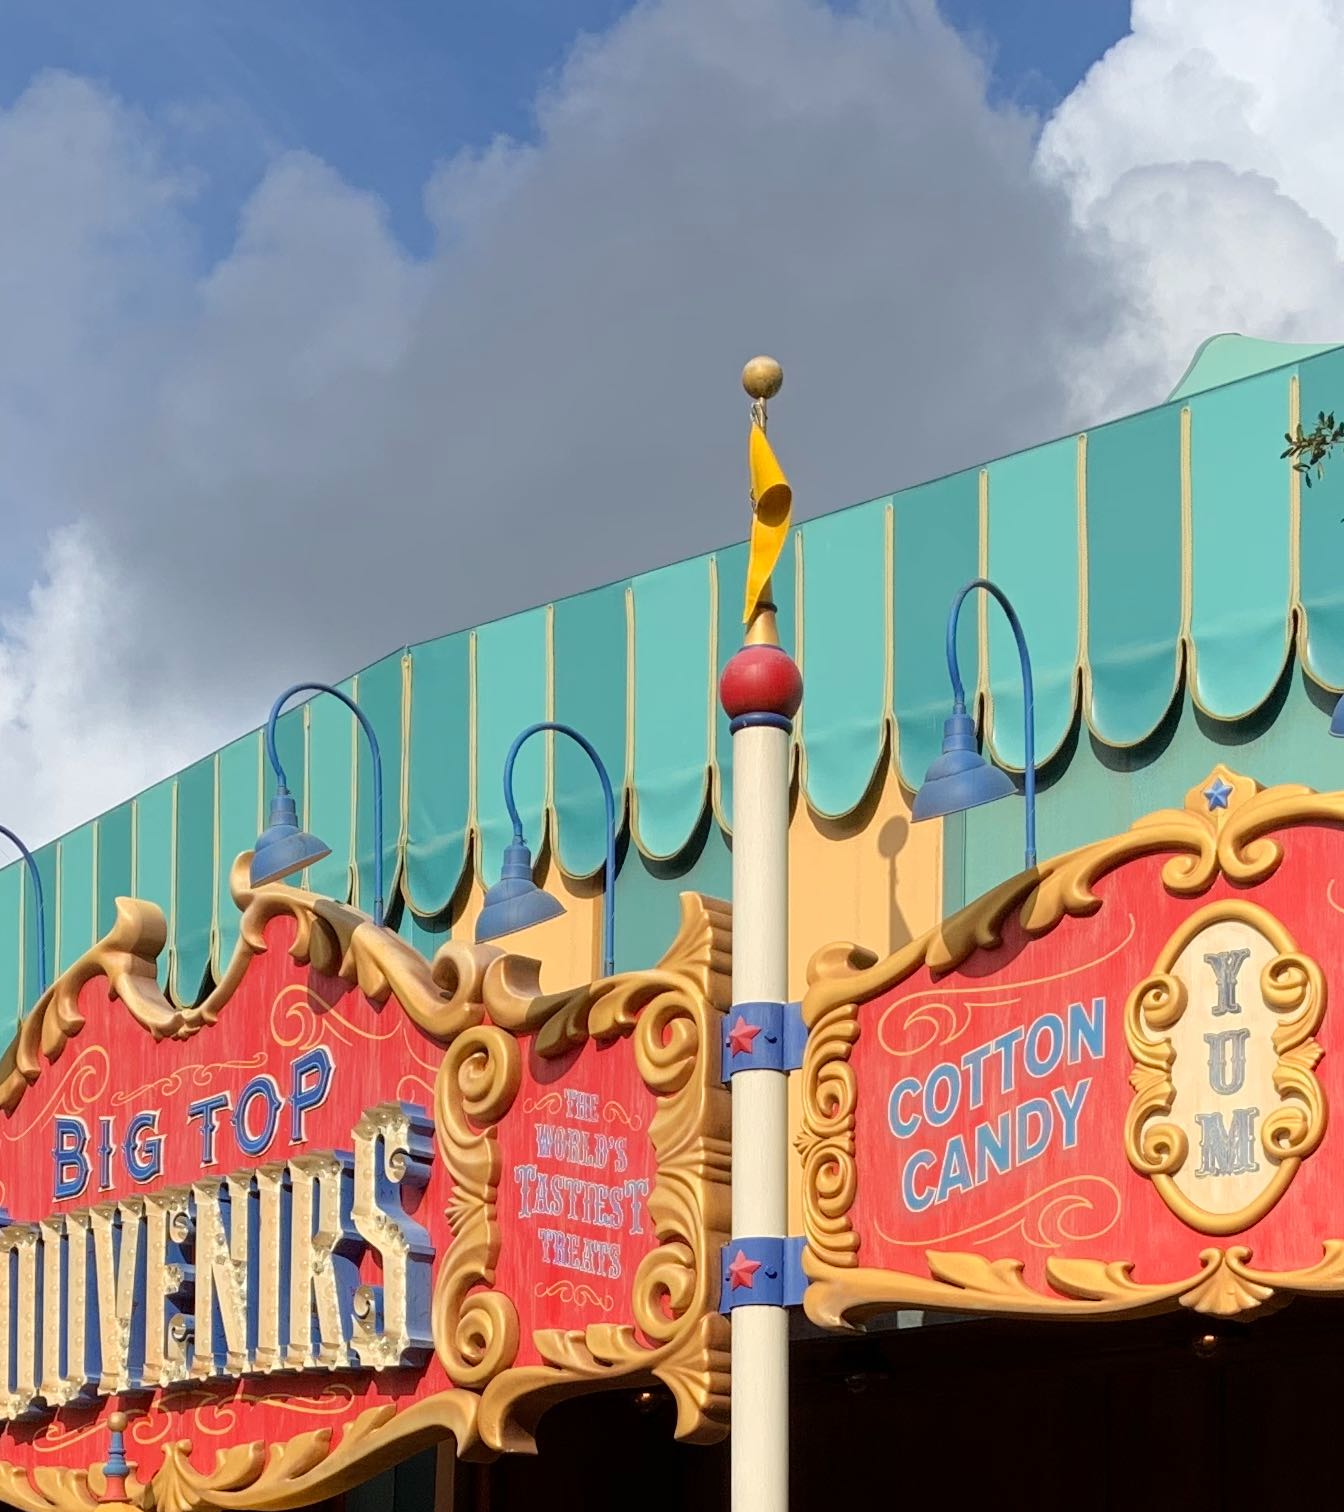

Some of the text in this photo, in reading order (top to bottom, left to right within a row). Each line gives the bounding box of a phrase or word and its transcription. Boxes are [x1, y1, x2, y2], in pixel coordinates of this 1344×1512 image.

[563, 1087, 599, 1123] THE
[887, 997, 1106, 1139] COTTON
[1194, 947, 1260, 1178] YUM
[52, 1044, 335, 1203] BIG TOP
[534, 1123, 628, 1174] WORLD'S
[900, 1078, 1093, 1213] CANDY
[513, 1163, 649, 1236] TASTIEST
[538, 1228, 621, 1280] TREATS
